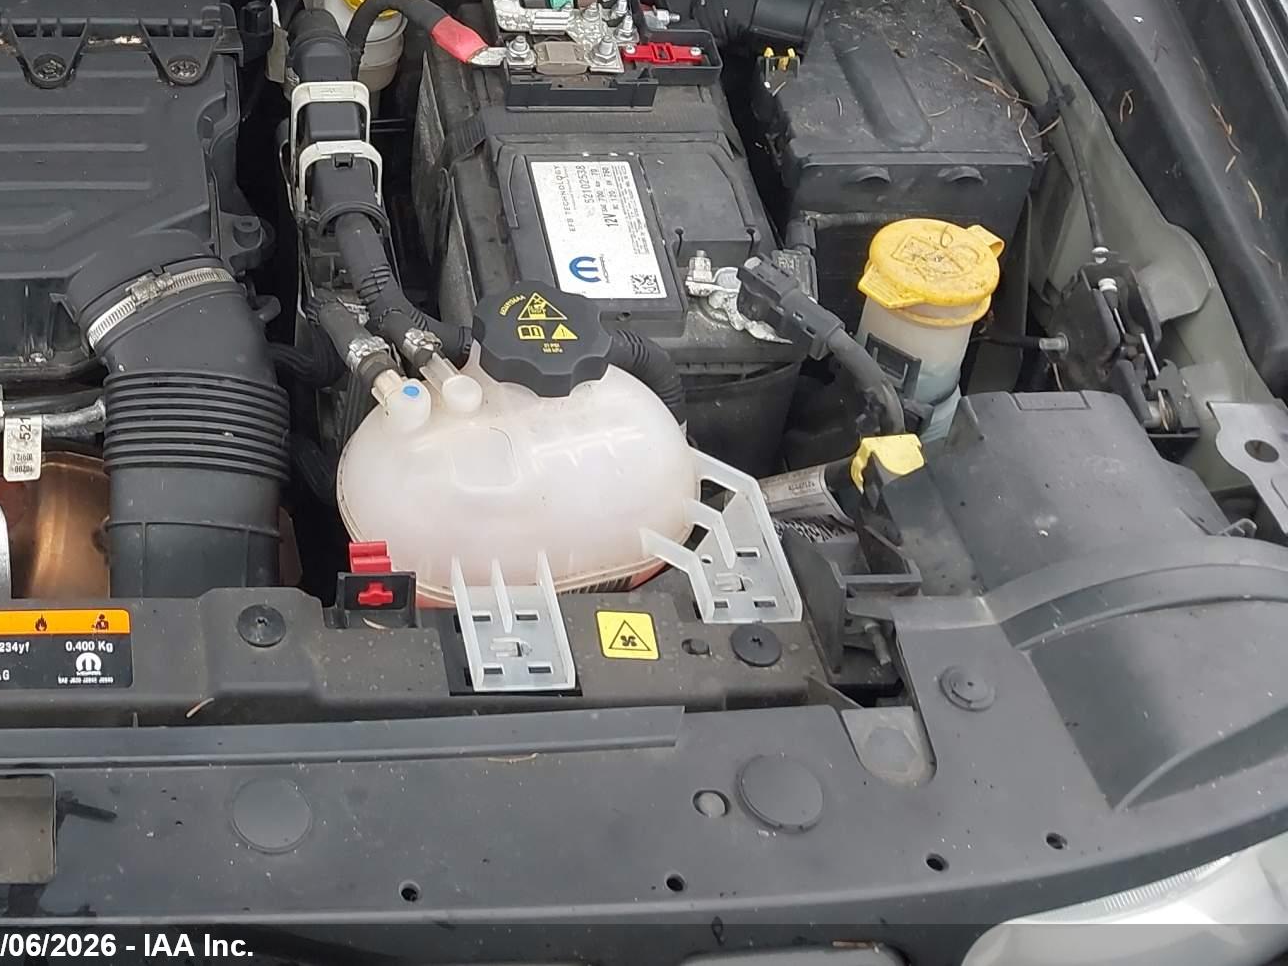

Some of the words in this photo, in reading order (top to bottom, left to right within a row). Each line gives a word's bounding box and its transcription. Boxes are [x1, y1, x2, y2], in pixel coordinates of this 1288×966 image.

[553, 165, 571, 214] TECHNOLOGY
[603, 213, 620, 227] 12V
[66, 641, 95, 651] 0.400
[98, 641, 113, 652] Kg
